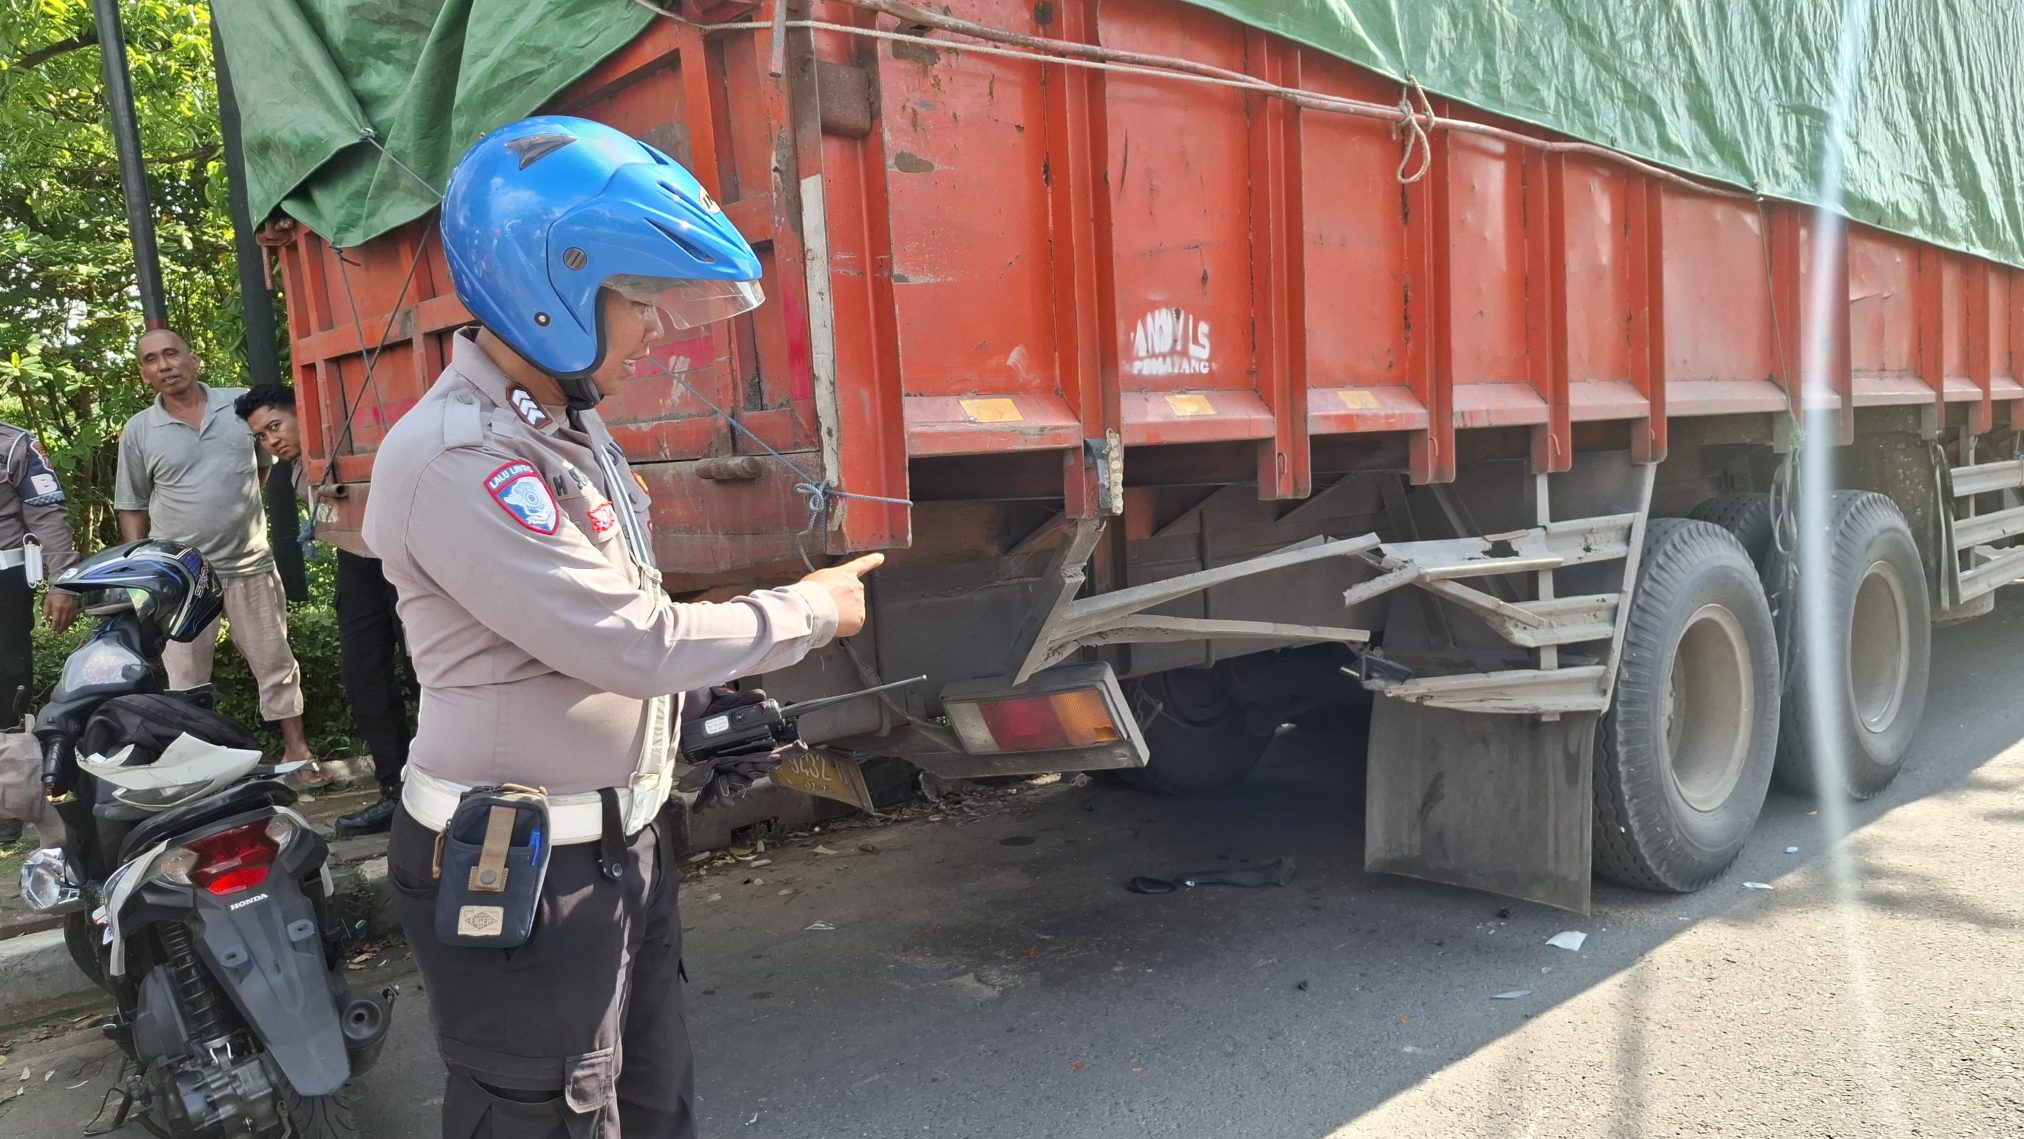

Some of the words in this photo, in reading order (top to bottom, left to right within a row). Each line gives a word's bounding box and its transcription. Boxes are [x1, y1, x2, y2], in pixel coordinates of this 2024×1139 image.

[31, 473, 58, 495] B
[489, 469, 511, 488] LALU
[230, 893, 269, 911] HONDA
[470, 915, 493, 925] EIGER
